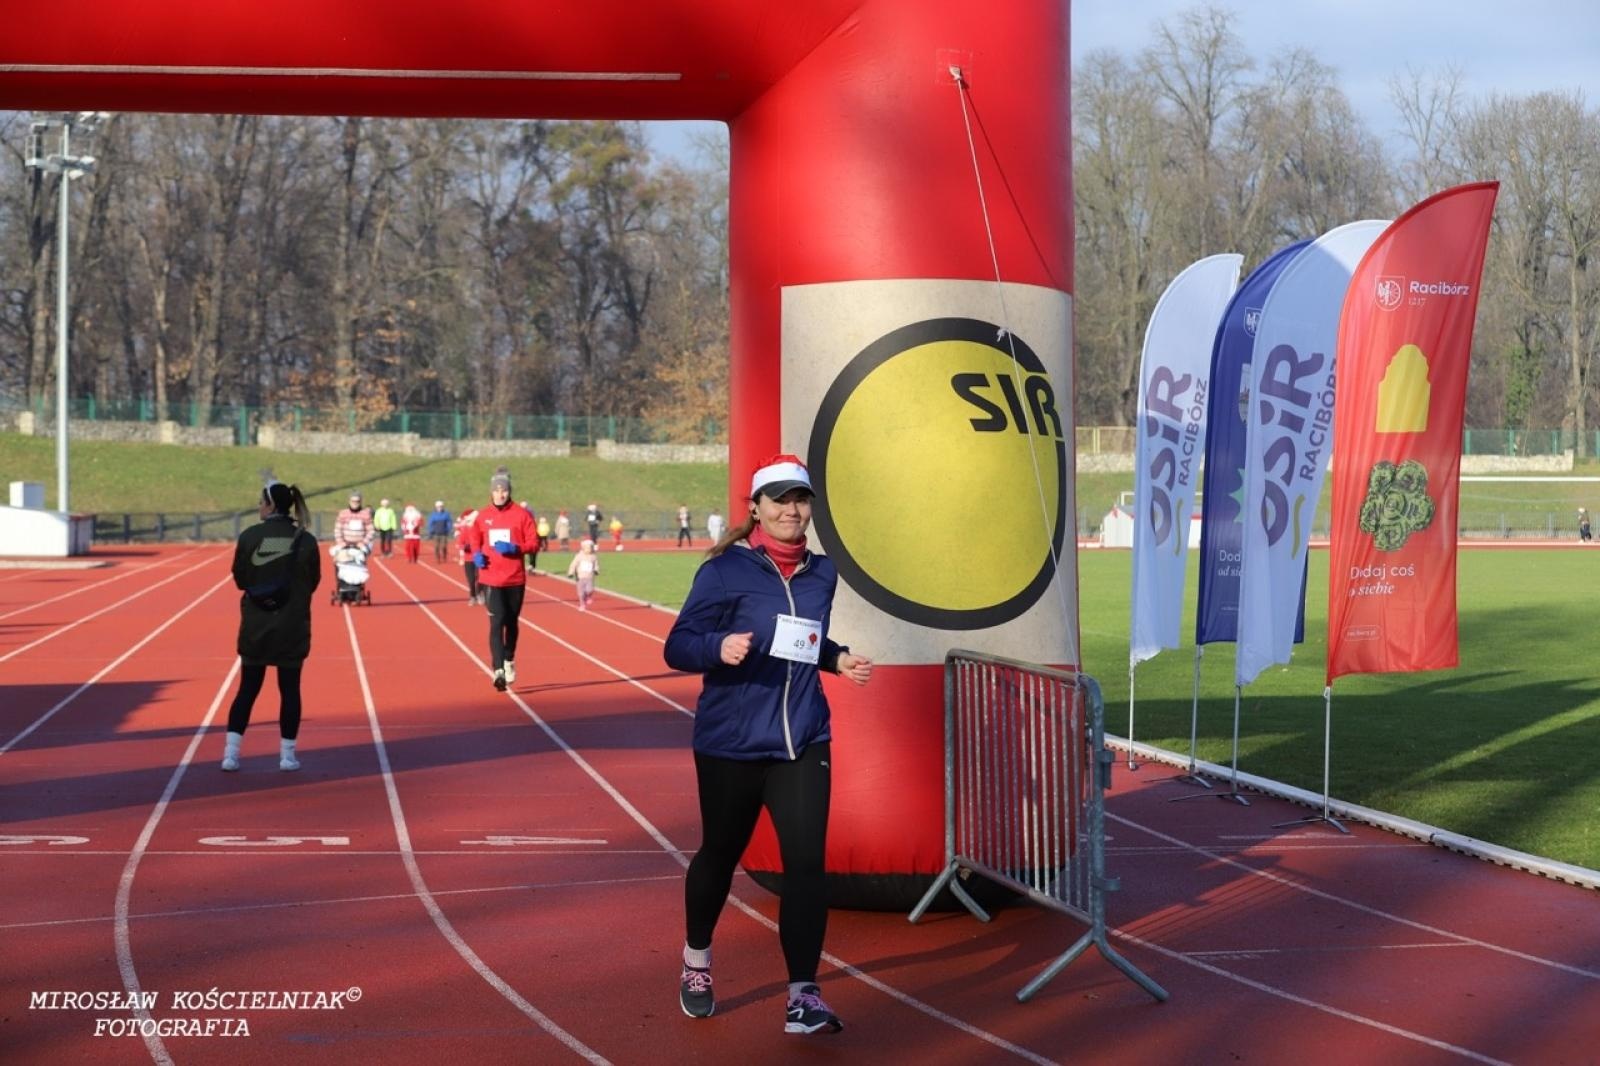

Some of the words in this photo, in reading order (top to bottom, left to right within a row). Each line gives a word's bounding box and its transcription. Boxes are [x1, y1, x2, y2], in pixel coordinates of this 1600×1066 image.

[1409, 280, 1470, 295] Racibórz
[1299, 357, 1337, 481] RACIBÓR
[1177, 377, 1207, 487] RACIBÓRZ
[1390, 563, 1416, 577] coś
[793, 639, 806, 650] 49
[197, 835, 351, 847] 5
